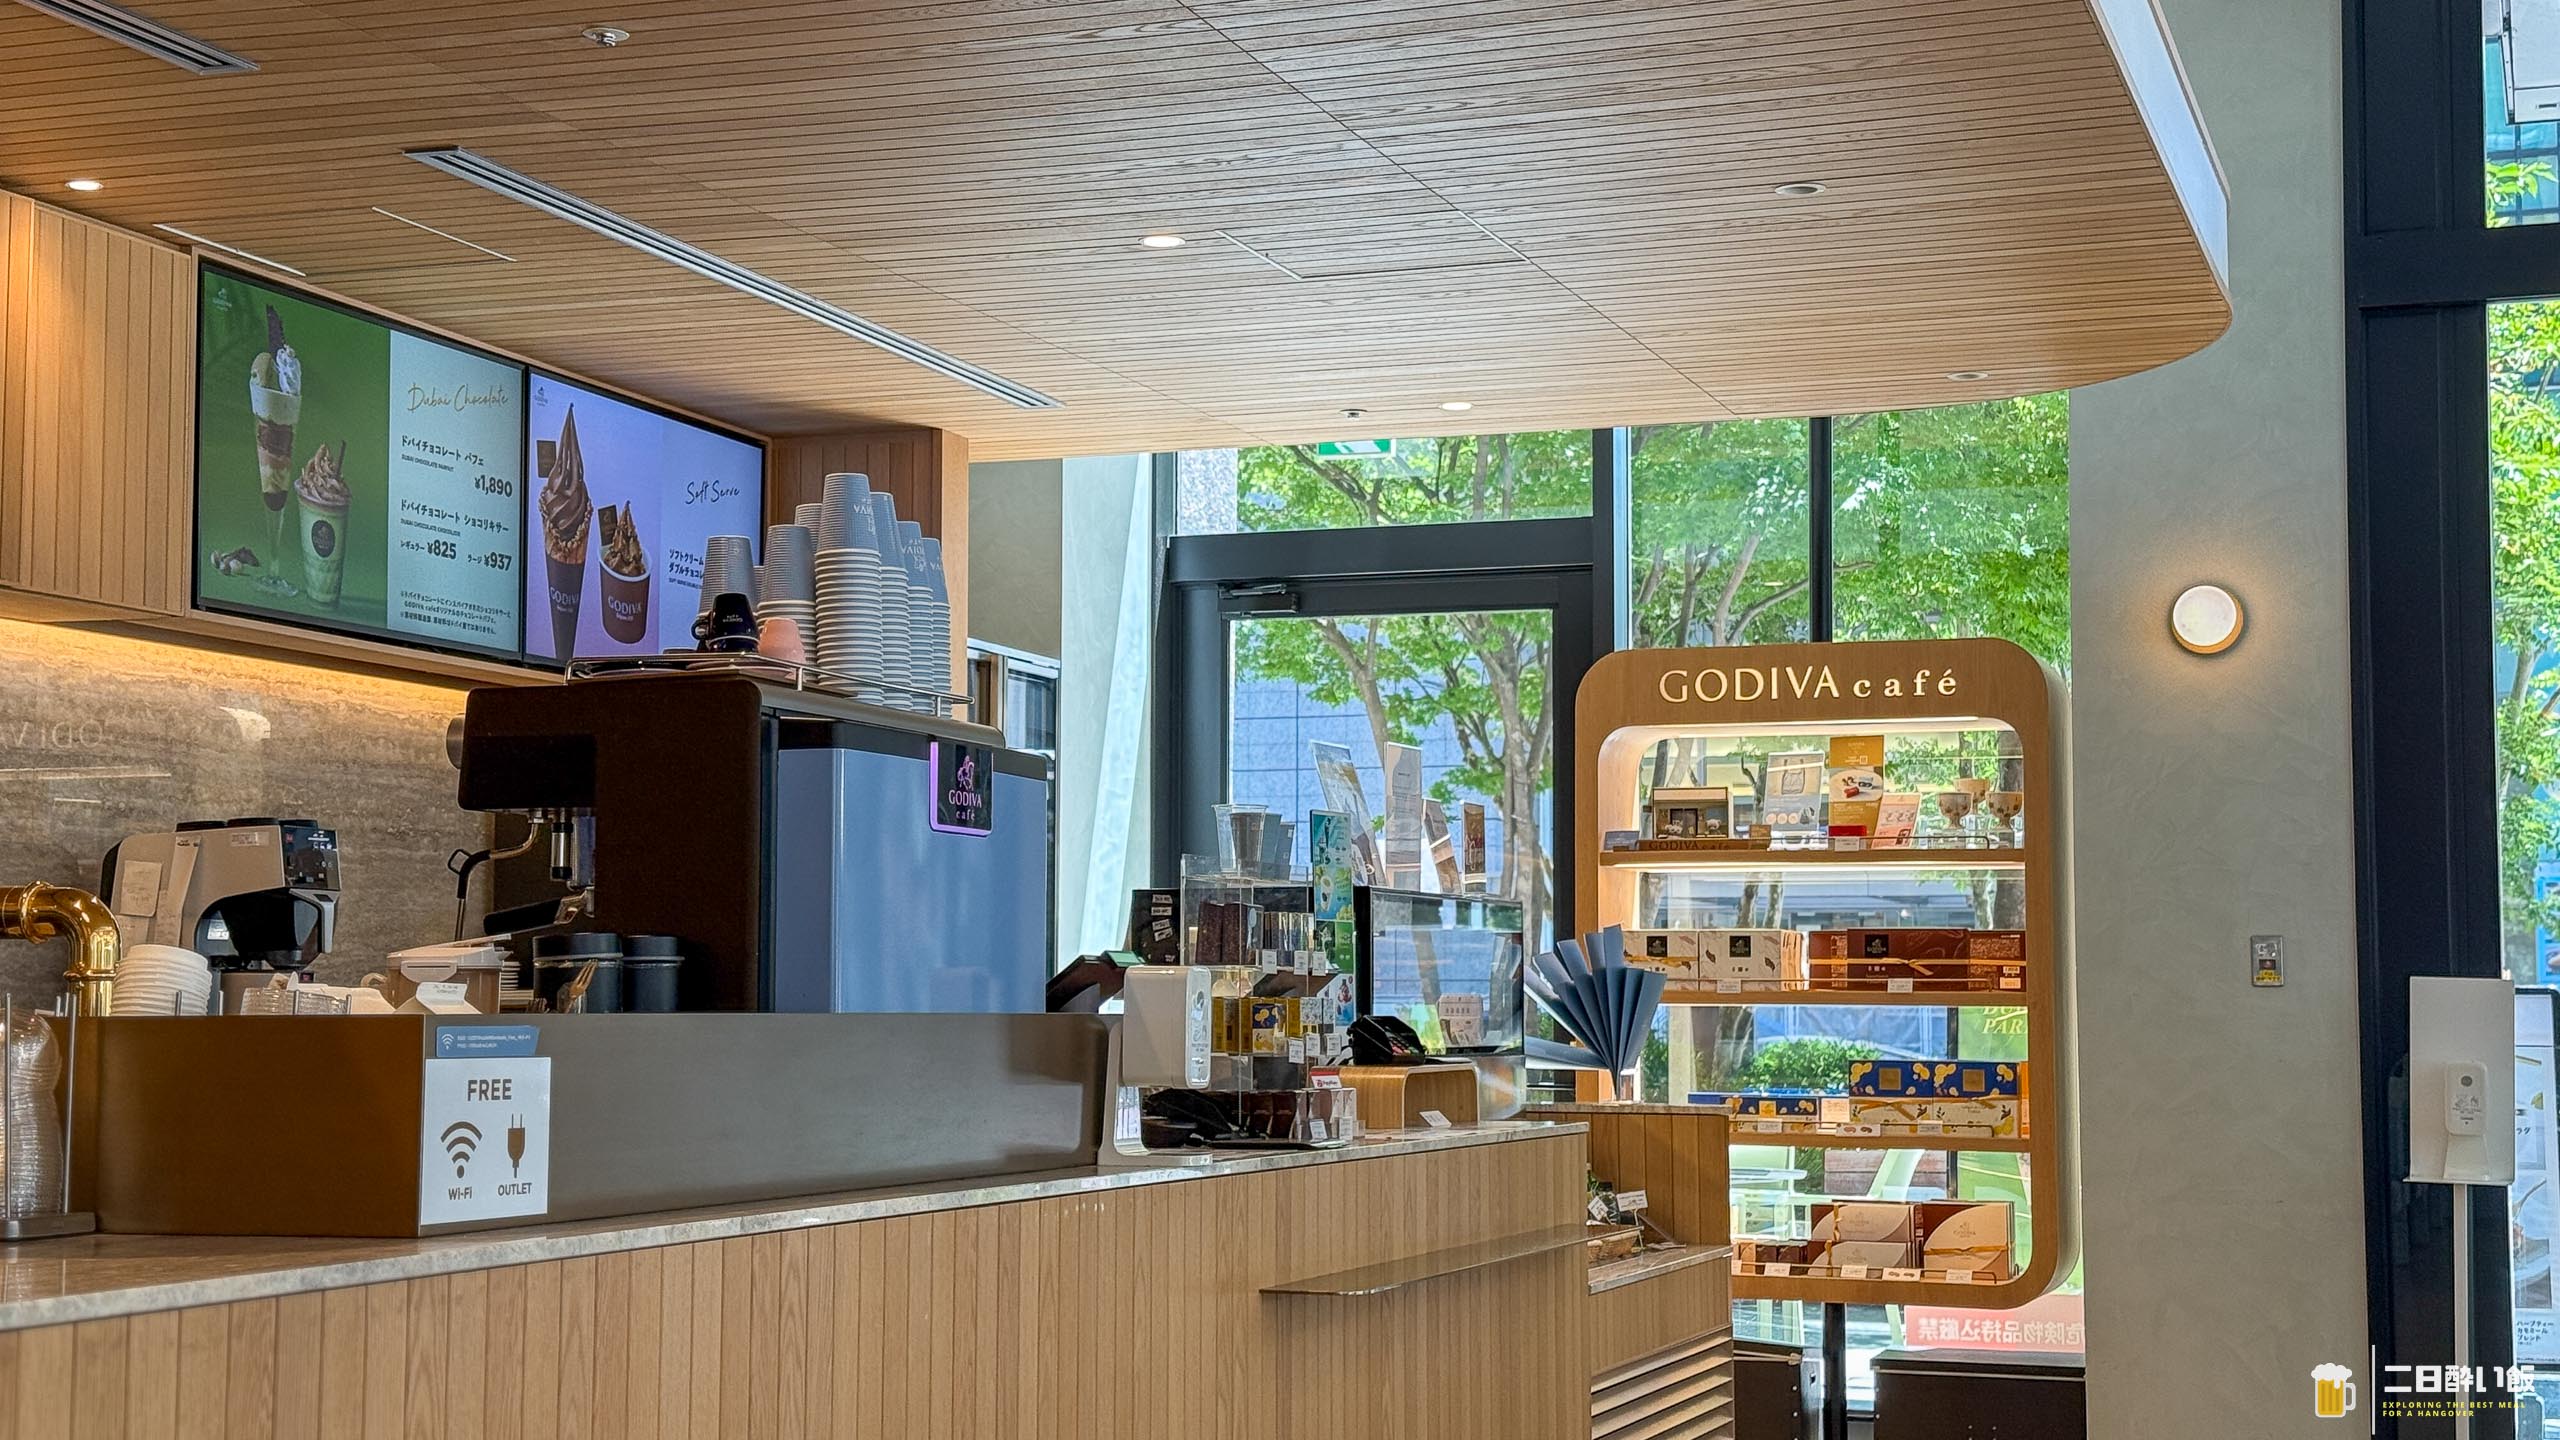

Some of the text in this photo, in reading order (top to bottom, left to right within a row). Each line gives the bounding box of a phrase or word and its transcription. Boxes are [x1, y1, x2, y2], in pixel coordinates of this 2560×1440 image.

[407, 382, 508, 413] Dubai Chocolate
[402, 435, 484, 466] ドバイチョコレート パフェ
[474, 475, 512, 497] ¥1,890
[685, 480, 740, 504] Soft Serve
[401, 499, 460, 524] ドバイチョコレート
[464, 514, 509, 533] ショコリキサー
[400, 539, 457, 560] レギュラー ¥825
[669, 548, 704, 566] ソフトクリーム
[467, 552, 512, 572] ラージ ¥937
[608, 595, 641, 615] GODIVA
[1659, 665, 1957, 703] GODIVA café
[948, 789, 982, 808] GODIVA
[1649, 840, 1698, 850] GODIVA
[1981, 1018, 2027, 1034] PAR
[467, 1078, 513, 1102] FREE
[448, 1186, 473, 1200] Wi-Fi
[497, 1182, 533, 1197] OUTLET
